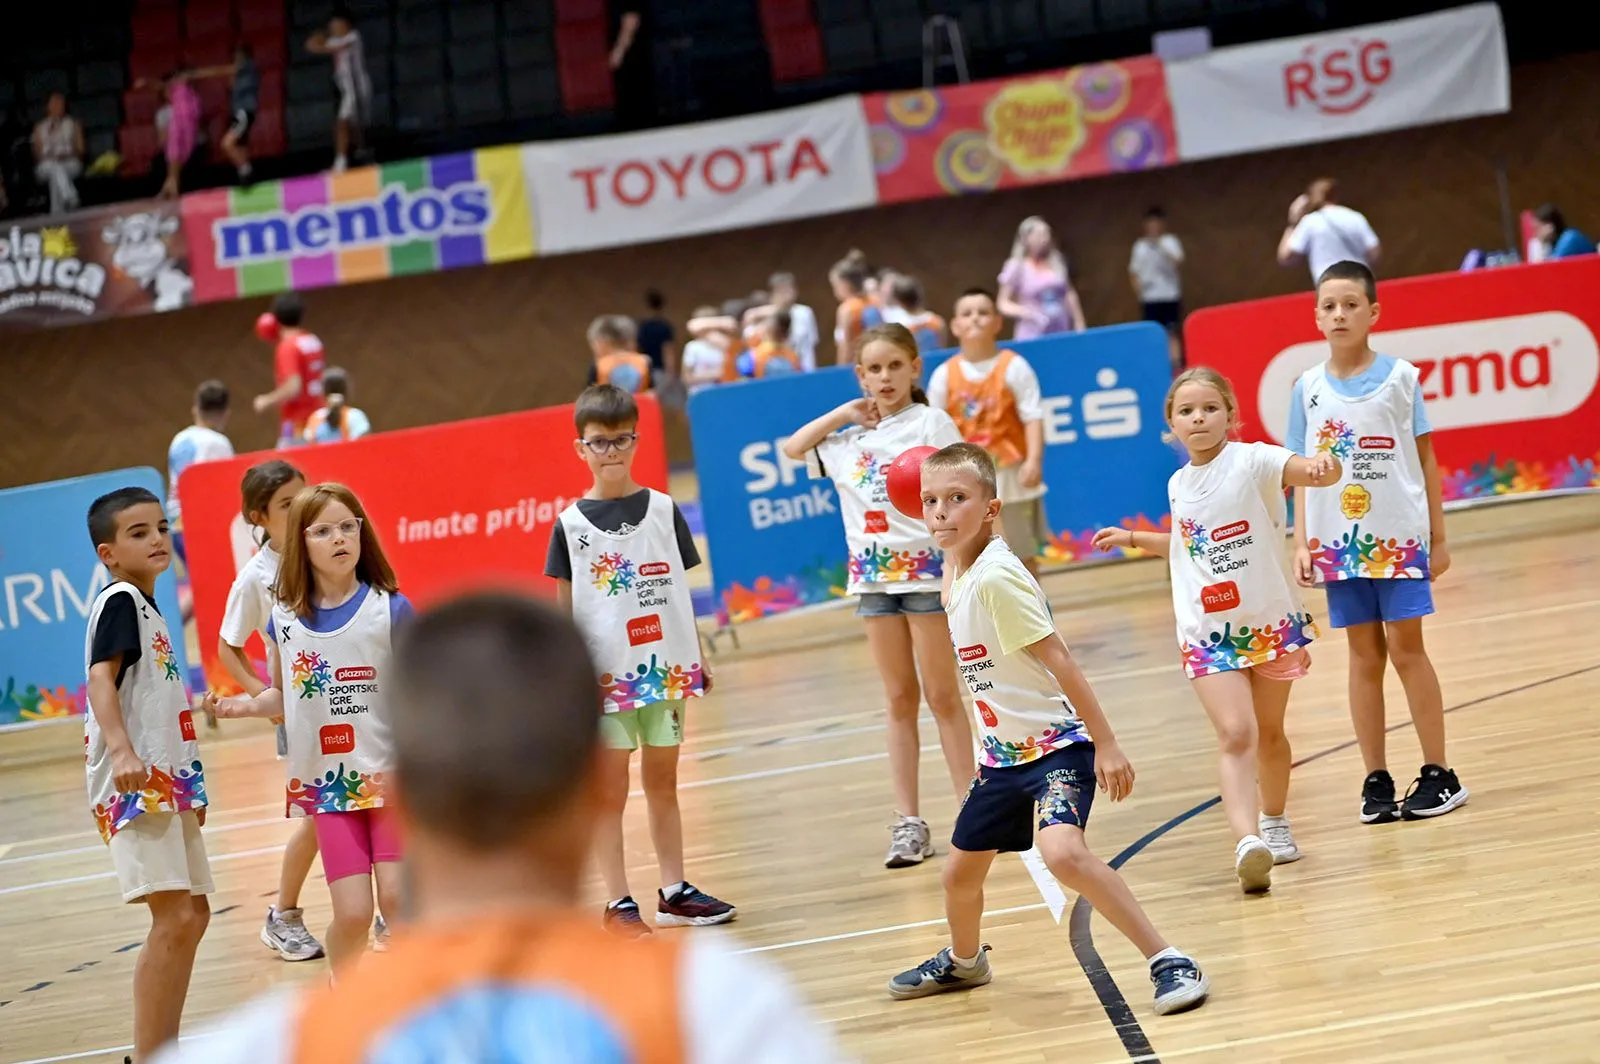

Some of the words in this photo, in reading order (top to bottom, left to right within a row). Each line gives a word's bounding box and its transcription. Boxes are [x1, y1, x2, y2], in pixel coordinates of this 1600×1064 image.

[1283, 40, 1392, 108] RSG
[571, 137, 830, 213] TOYOTA
[219, 187, 489, 260] mentos
[1352, 452, 1396, 461] SPORTSKE
[1352, 462, 1372, 471] IGRE
[1352, 472, 1388, 480] MLADIH
[749, 485, 836, 530] Bank
[398, 516, 478, 543] imate
[1207, 536, 1254, 557] SPORTSKE
[1210, 553, 1231, 566] IGRE
[1212, 559, 1249, 575] MLADIH
[0, 562, 110, 629] RM
[1204, 589, 1235, 605] m:tel
[631, 621, 661, 637] m:tel
[338, 670, 374, 680] plazma
[328, 684, 379, 696] SPORTSKE
[970, 681, 994, 693] LADIH
[329, 696, 353, 706] IGRE
[330, 705, 369, 716] MLADIH
[324, 732, 351, 745] m:tel
